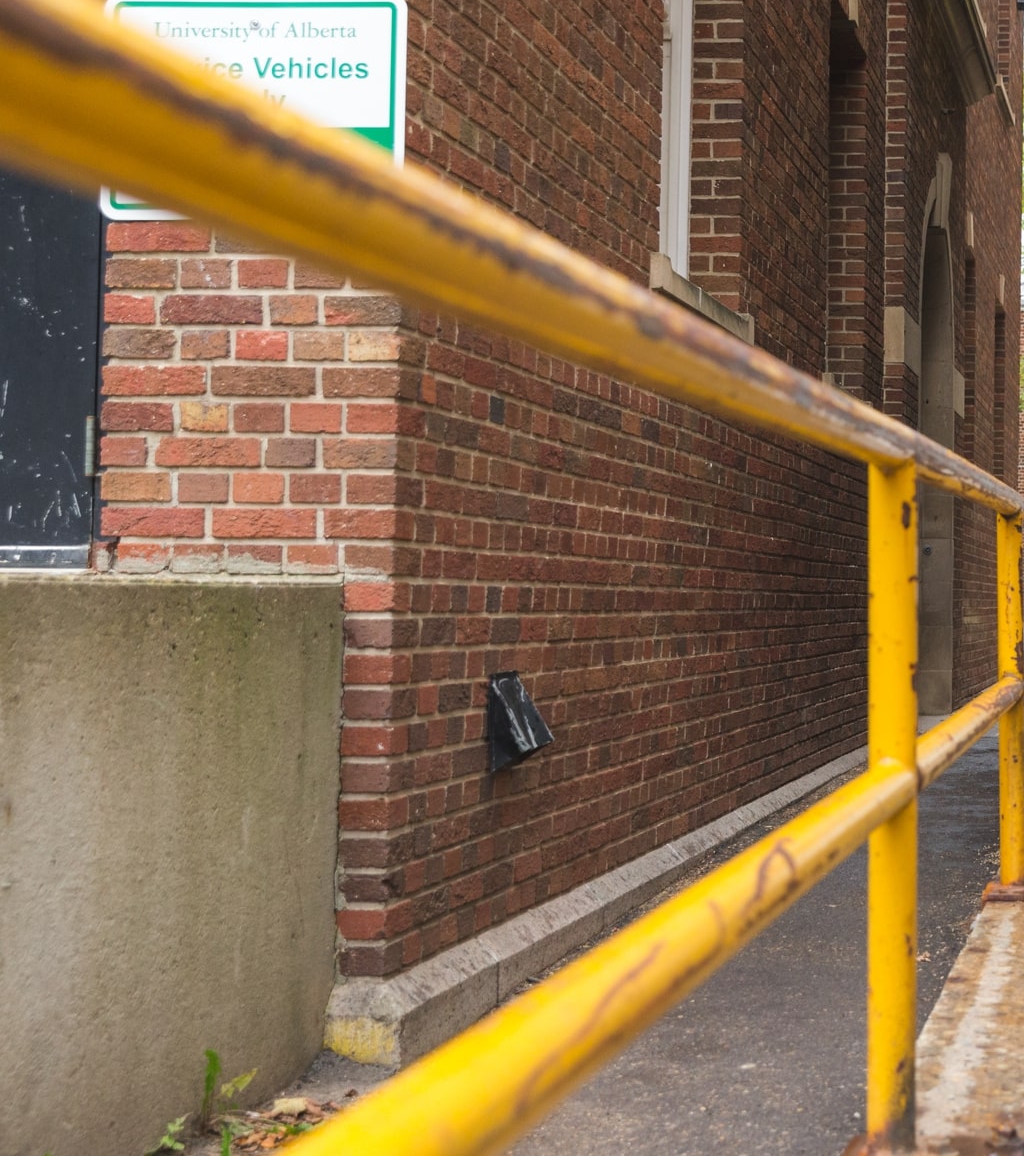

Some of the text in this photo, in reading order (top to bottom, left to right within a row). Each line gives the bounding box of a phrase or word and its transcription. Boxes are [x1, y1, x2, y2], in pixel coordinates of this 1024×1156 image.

[154, 21, 357, 42] University of Alberta
[253, 56, 370, 79] Vehicles
